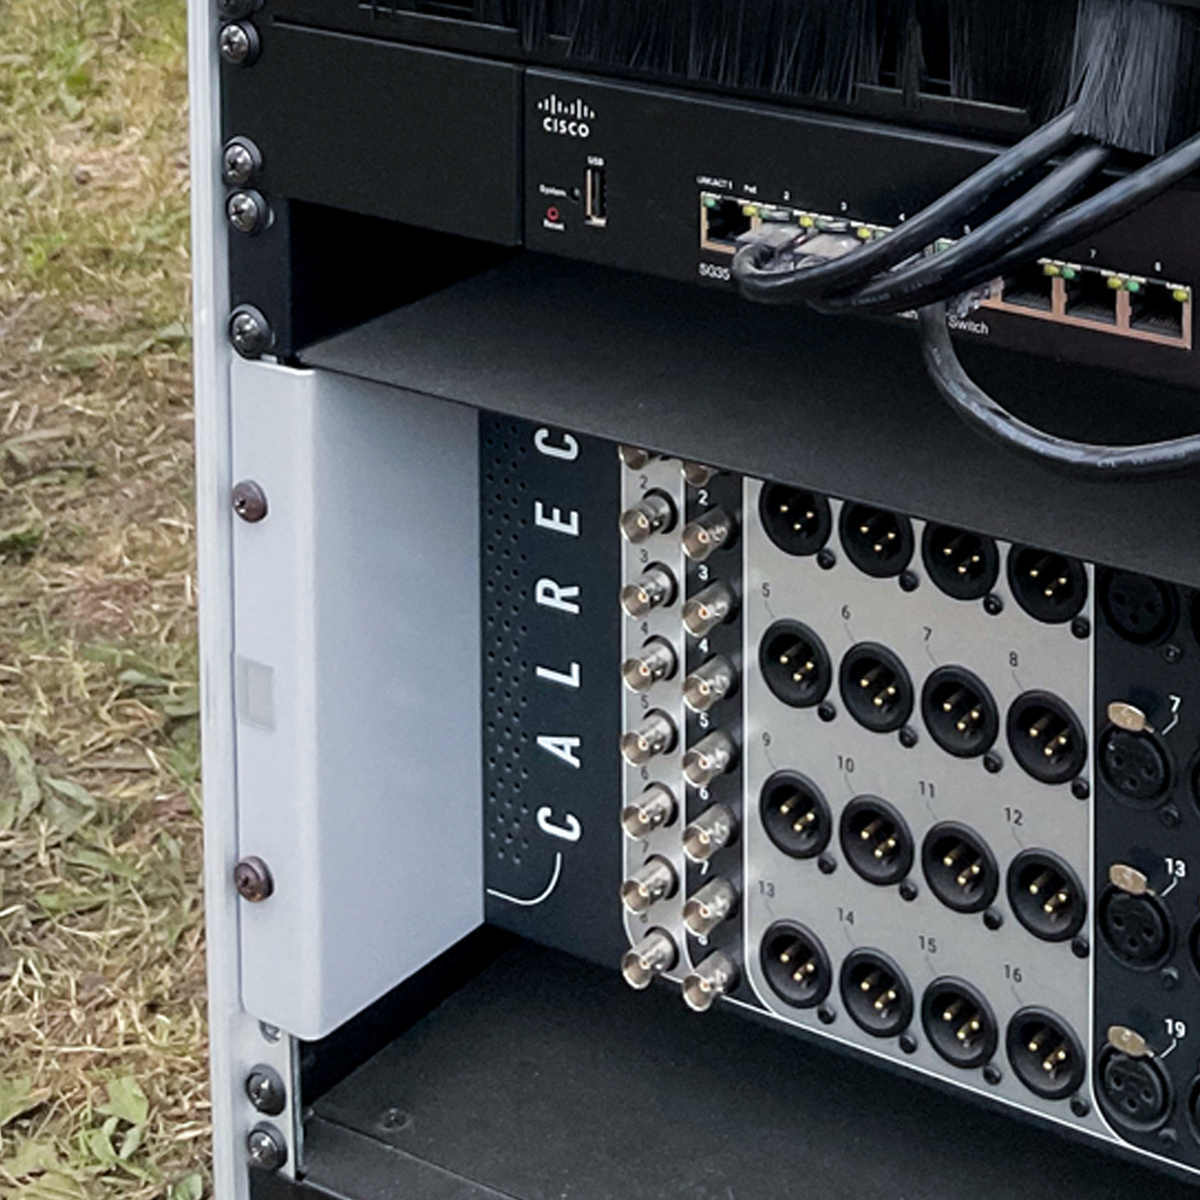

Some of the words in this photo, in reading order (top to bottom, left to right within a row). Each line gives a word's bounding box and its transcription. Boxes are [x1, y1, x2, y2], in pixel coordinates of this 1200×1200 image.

[542, 117, 590, 138] cisco
[948, 313, 989, 336] Switch
[698, 489, 709, 506] 2
[698, 564, 709, 581] 3
[762, 583, 770, 598] 5
[841, 605, 851, 620] 6
[534, 426, 582, 842] CALREC
[922, 626, 932, 641] 7
[698, 638, 709, 653] 4
[1009, 651, 1019, 667] 8
[1169, 695, 1181, 712] 7
[700, 713, 709, 727] 5
[762, 732, 771, 747] 9
[837, 755, 855, 773] 10
[700, 786, 709, 800] 6
[918, 780, 936, 798] 11
[1004, 807, 1023, 826] 12
[700, 860, 709, 875] 7
[1165, 858, 1186, 878] 13
[758, 880, 776, 899] 13
[837, 907, 855, 926] 14
[918, 935, 937, 954] 15
[1004, 964, 1023, 983] 16
[1165, 1018, 1186, 1039] 19
